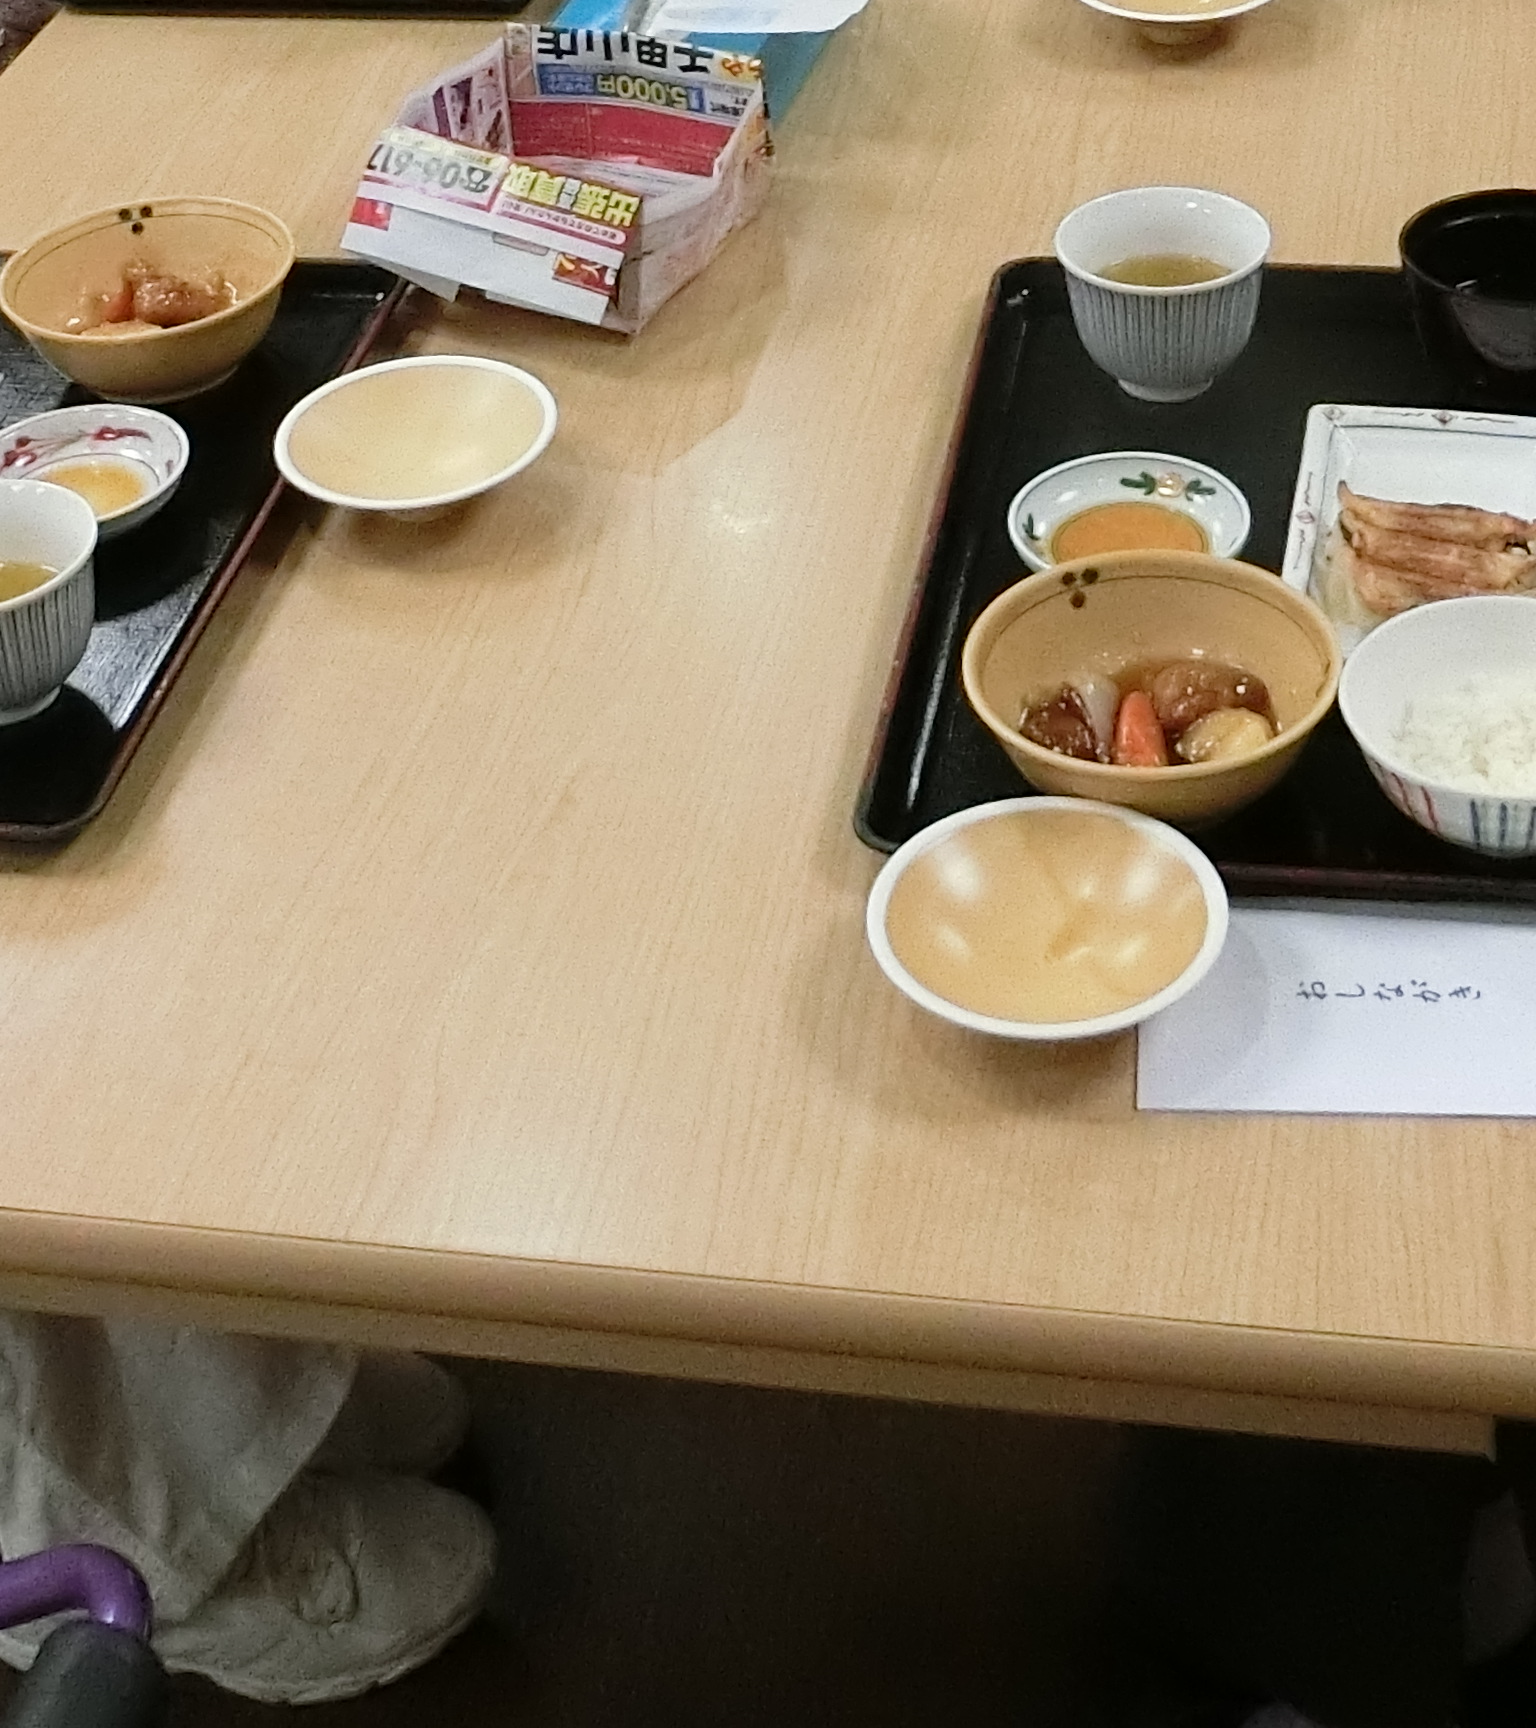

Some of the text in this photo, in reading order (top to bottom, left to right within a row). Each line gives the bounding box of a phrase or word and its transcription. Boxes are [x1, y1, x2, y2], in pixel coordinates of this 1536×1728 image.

[1295, 979, 1482, 1004] おしながき
